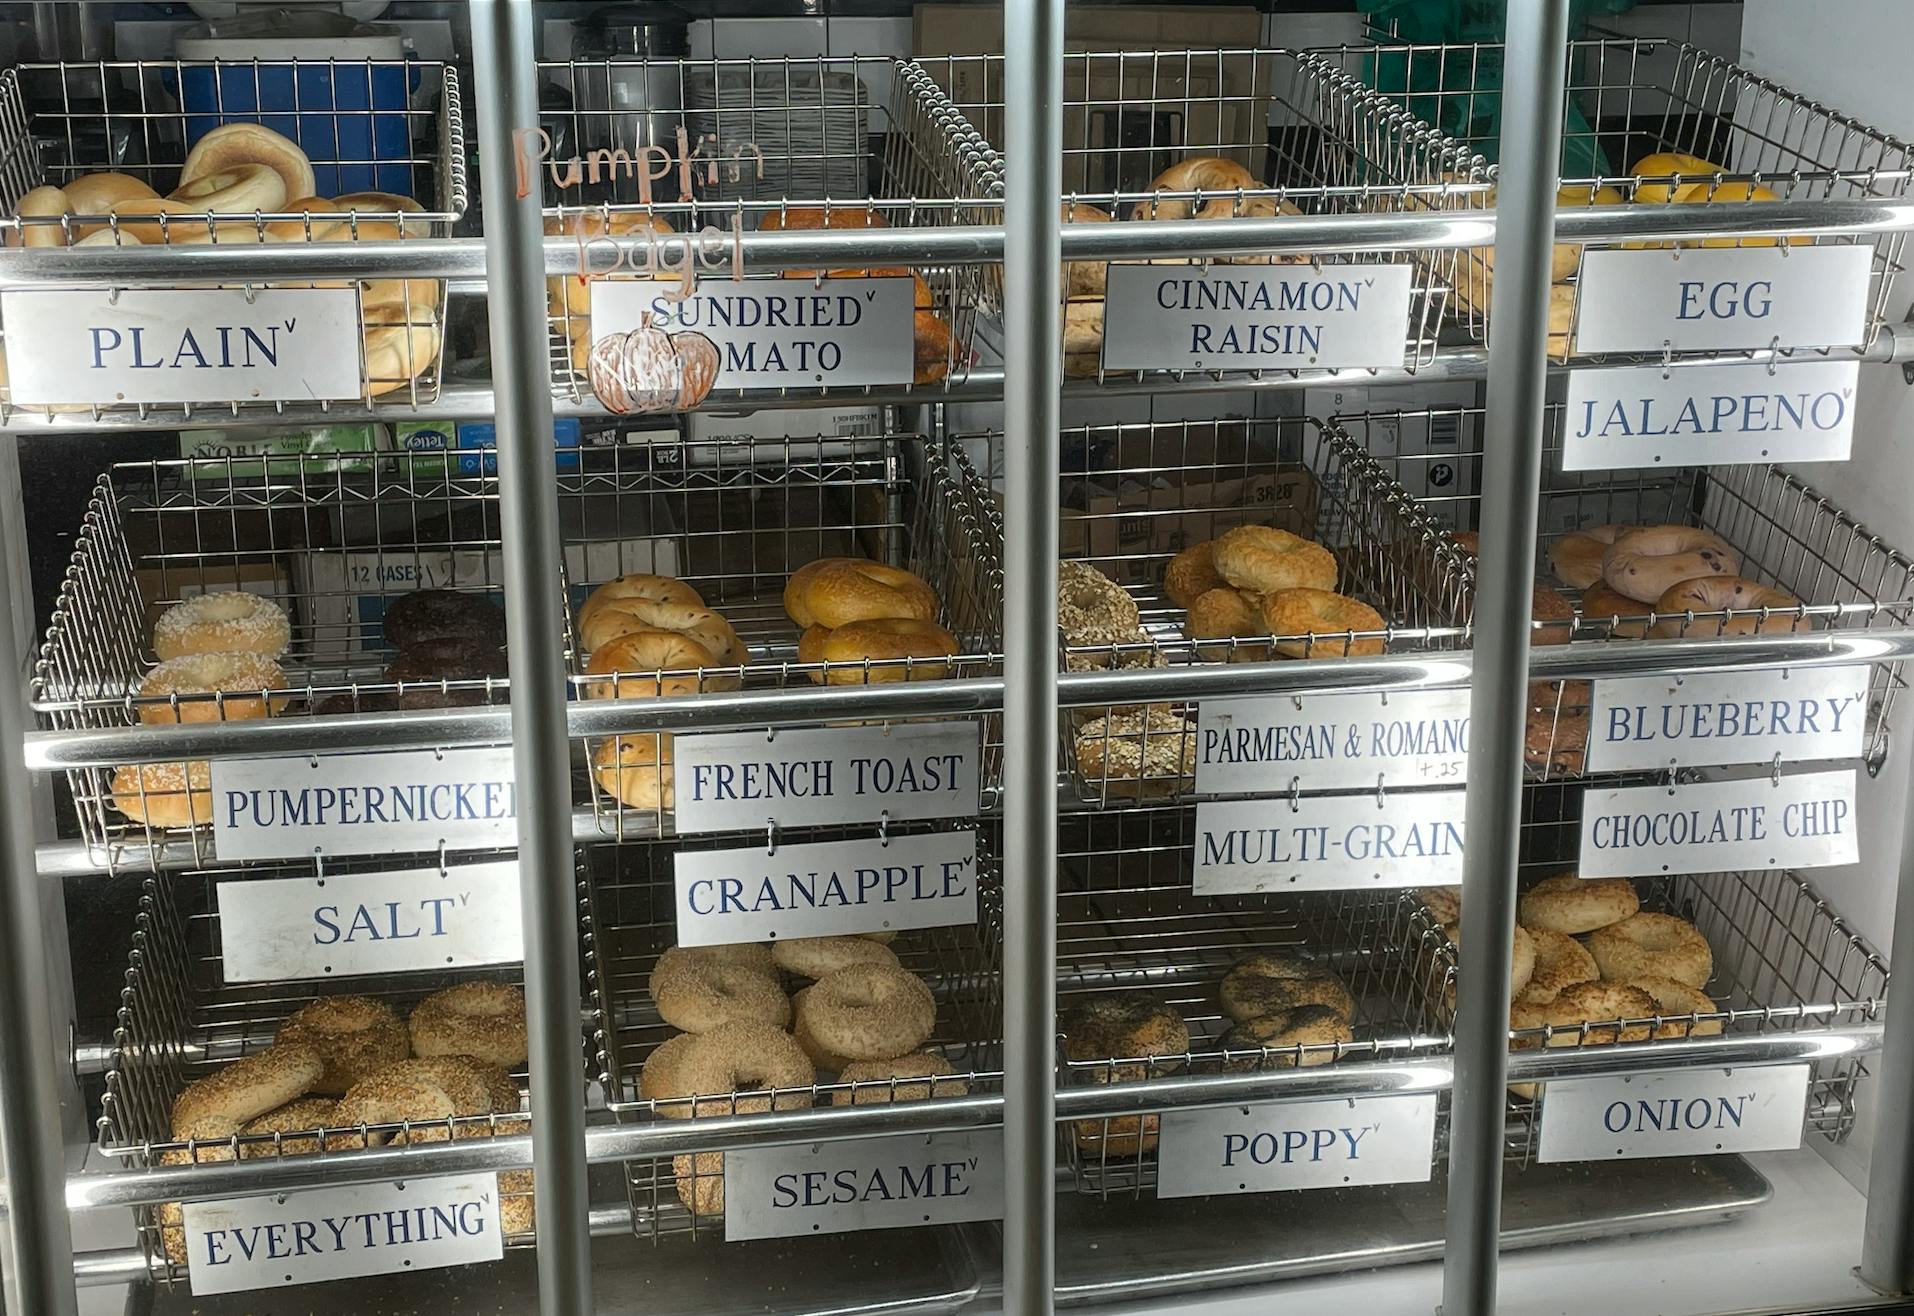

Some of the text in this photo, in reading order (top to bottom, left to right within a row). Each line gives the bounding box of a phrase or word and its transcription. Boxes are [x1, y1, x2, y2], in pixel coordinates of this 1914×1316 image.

[512, 125, 763, 204] Pumpkin
[651, 295, 861, 327] SUNDRIED
[1157, 279, 1363, 312] CINNAMON
[1675, 281, 1772, 320] EGG
[88, 327, 280, 369] PLAIN
[725, 341, 842, 373] MATO
[1189, 323, 1324, 355] RAISIN
[1576, 392, 1845, 439] JALAPENO
[406, 435, 445, 448] Tetley
[352, 565, 422, 582] 12 CASES
[1605, 698, 1853, 742] BLUEBERRY
[1203, 724, 1336, 764] PARMESAN
[1344, 723, 1362, 758] &
[692, 755, 963, 801] FRENCH TOAST
[1201, 821, 1465, 866] MULTI-GRAIN
[1592, 799, 1847, 849] CHOCOLATE CHIP
[688, 862, 967, 915] CRANAPPLE
[313, 898, 455, 945] SALT
[1604, 1096, 1747, 1133] ONION
[1221, 1126, 1372, 1167] POPPY
[773, 1161, 970, 1208] SESAME
[203, 1201, 484, 1266] EVERYTHING
